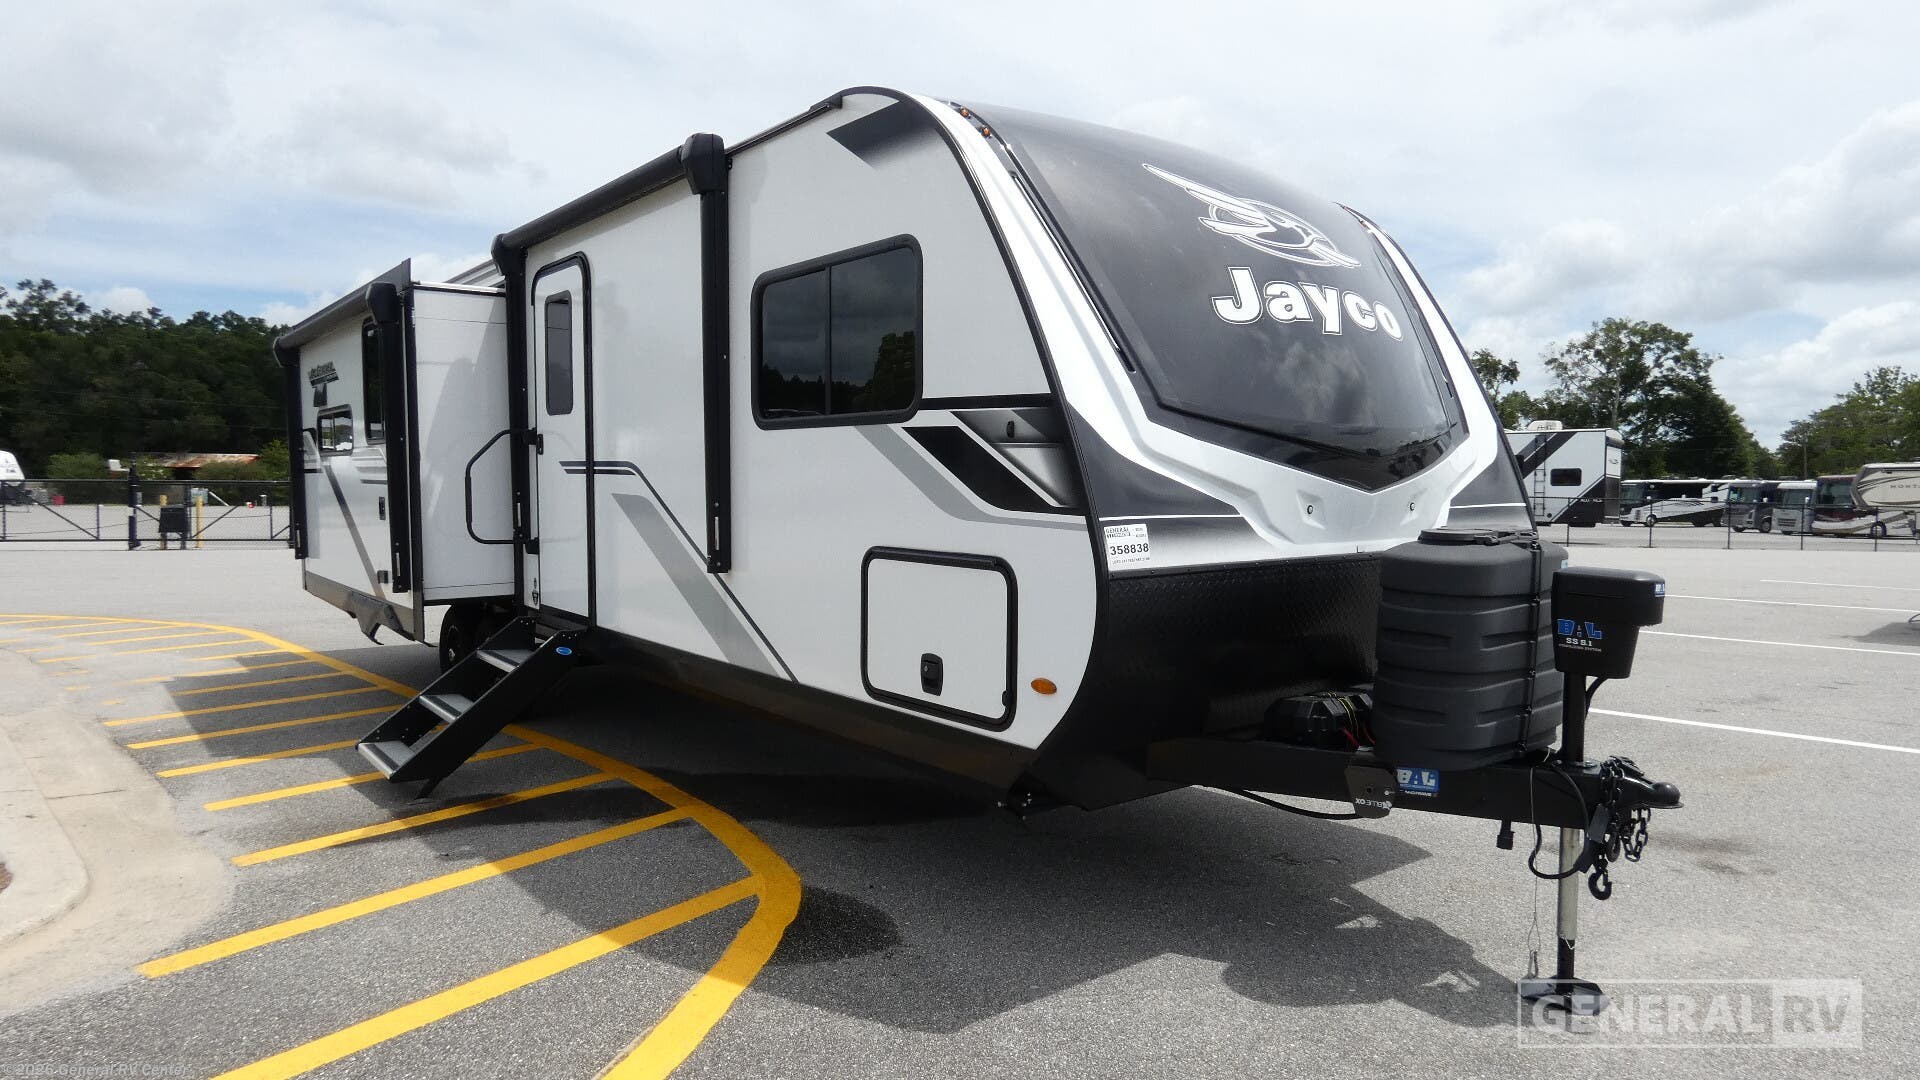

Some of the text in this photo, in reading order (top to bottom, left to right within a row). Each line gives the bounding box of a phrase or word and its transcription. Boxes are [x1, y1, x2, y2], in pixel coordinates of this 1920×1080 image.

[1211, 266, 1403, 341] Jayco
[1110, 542, 1149, 555] 358838
[1396, 768, 1436, 786] BAL
